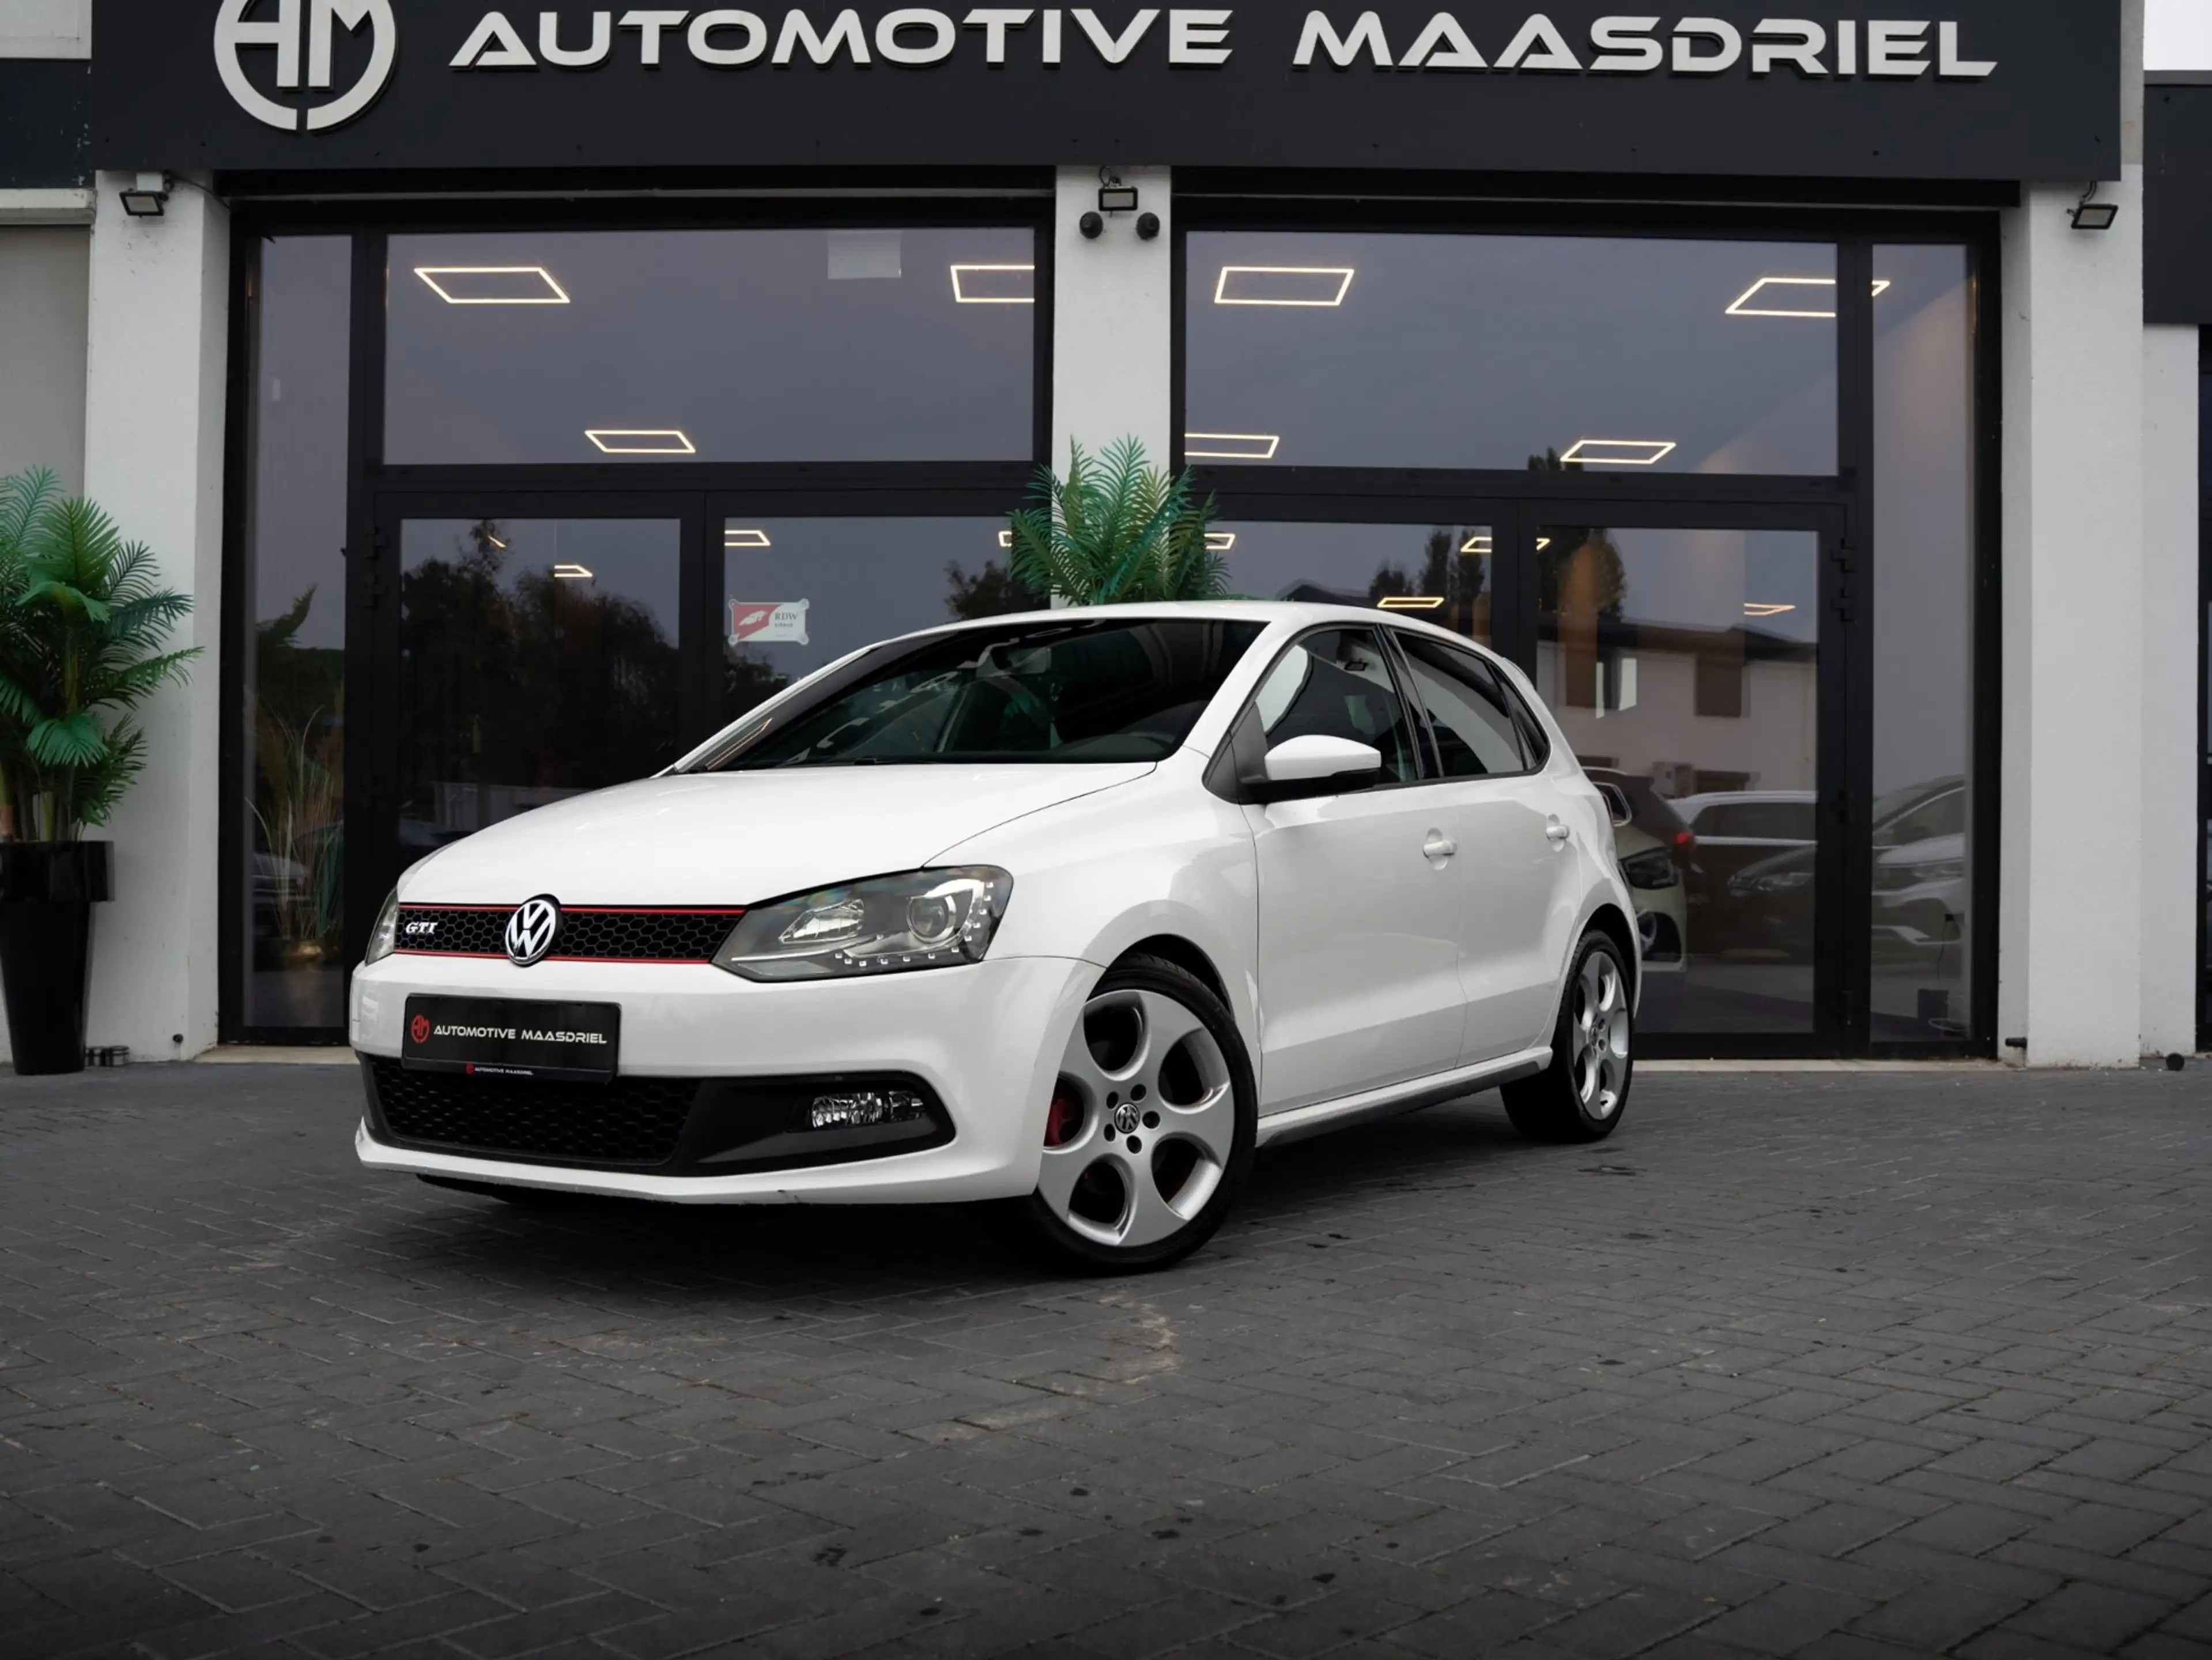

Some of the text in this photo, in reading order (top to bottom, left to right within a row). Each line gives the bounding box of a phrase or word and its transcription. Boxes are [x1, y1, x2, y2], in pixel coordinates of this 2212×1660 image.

[449, 8, 1998, 77] AUTOMOTIVE MAASDRIEL
[775, 612, 798, 621] RDW
[405, 921, 438, 934] GTI
[433, 1025, 607, 1044] AUTOMOTIVE MAASDRIEL
